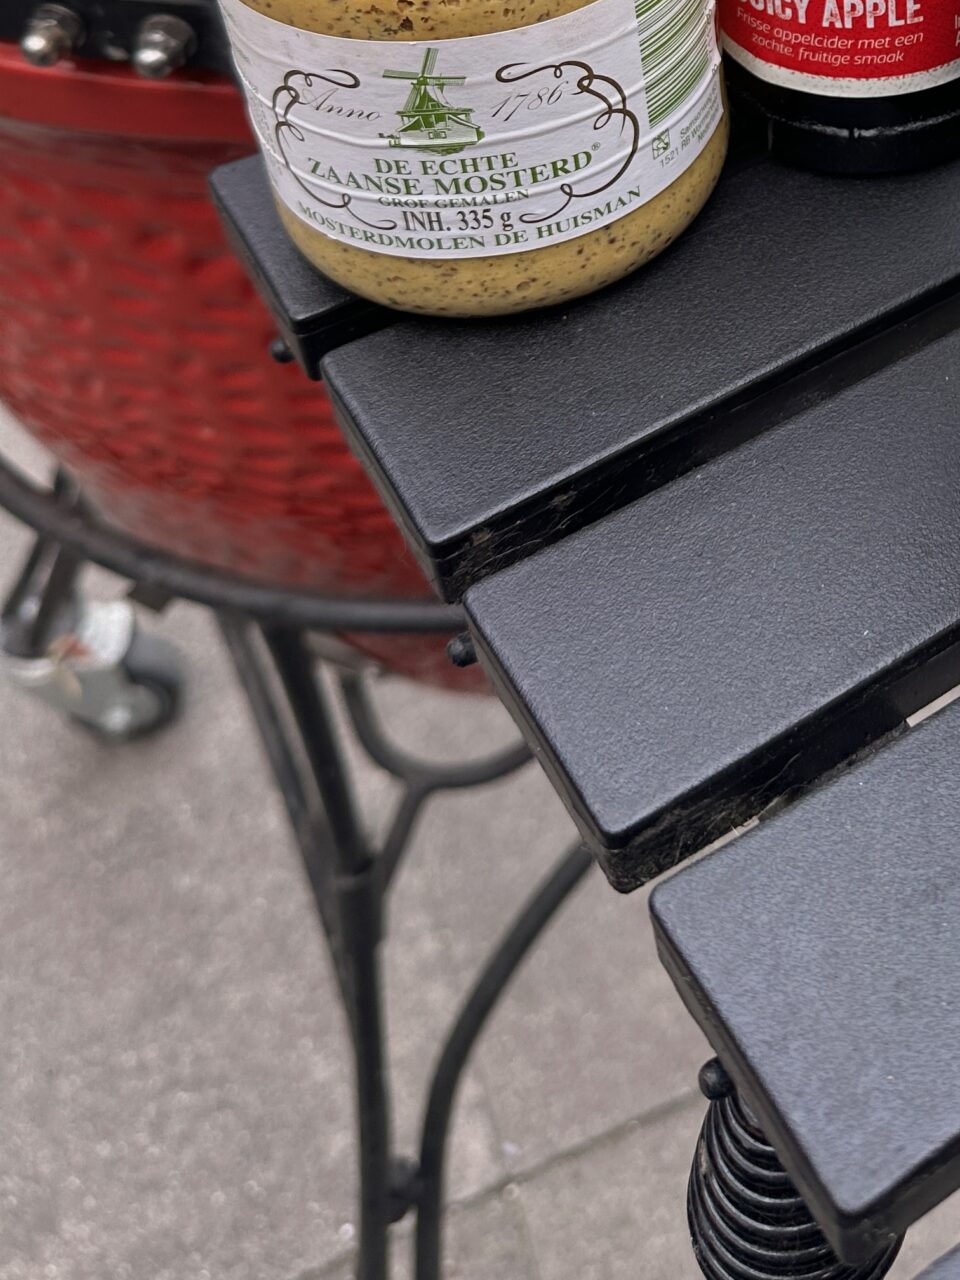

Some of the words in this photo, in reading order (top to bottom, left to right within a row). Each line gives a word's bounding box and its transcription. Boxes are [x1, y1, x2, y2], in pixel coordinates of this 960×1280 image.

[737, 6, 771, 33] Frisse
[773, 27, 855, 49] appelcider
[857, 36, 891, 50] met
[895, 32, 924, 47] een
[798, 47, 850, 67] fruitige
[854, 50, 904, 65] smaak
[301, 87, 382, 121] Anno
[490, 81, 569, 122] 1786
[307, 157, 423, 196] ZAANSE
[373, 158, 412, 176] DE
[419, 152, 519, 176] ECHTE
[378, 196, 429, 209] GROF
[434, 188, 530, 209] GEMALEN
[298, 200, 486, 250] MOSTERDMOLEN
[495, 230, 529, 247] DE
[536, 185, 641, 239] HUISMAN
[402, 210, 451, 232] INH.
[456, 208, 494, 231] 335
[500, 211, 514, 232] g
